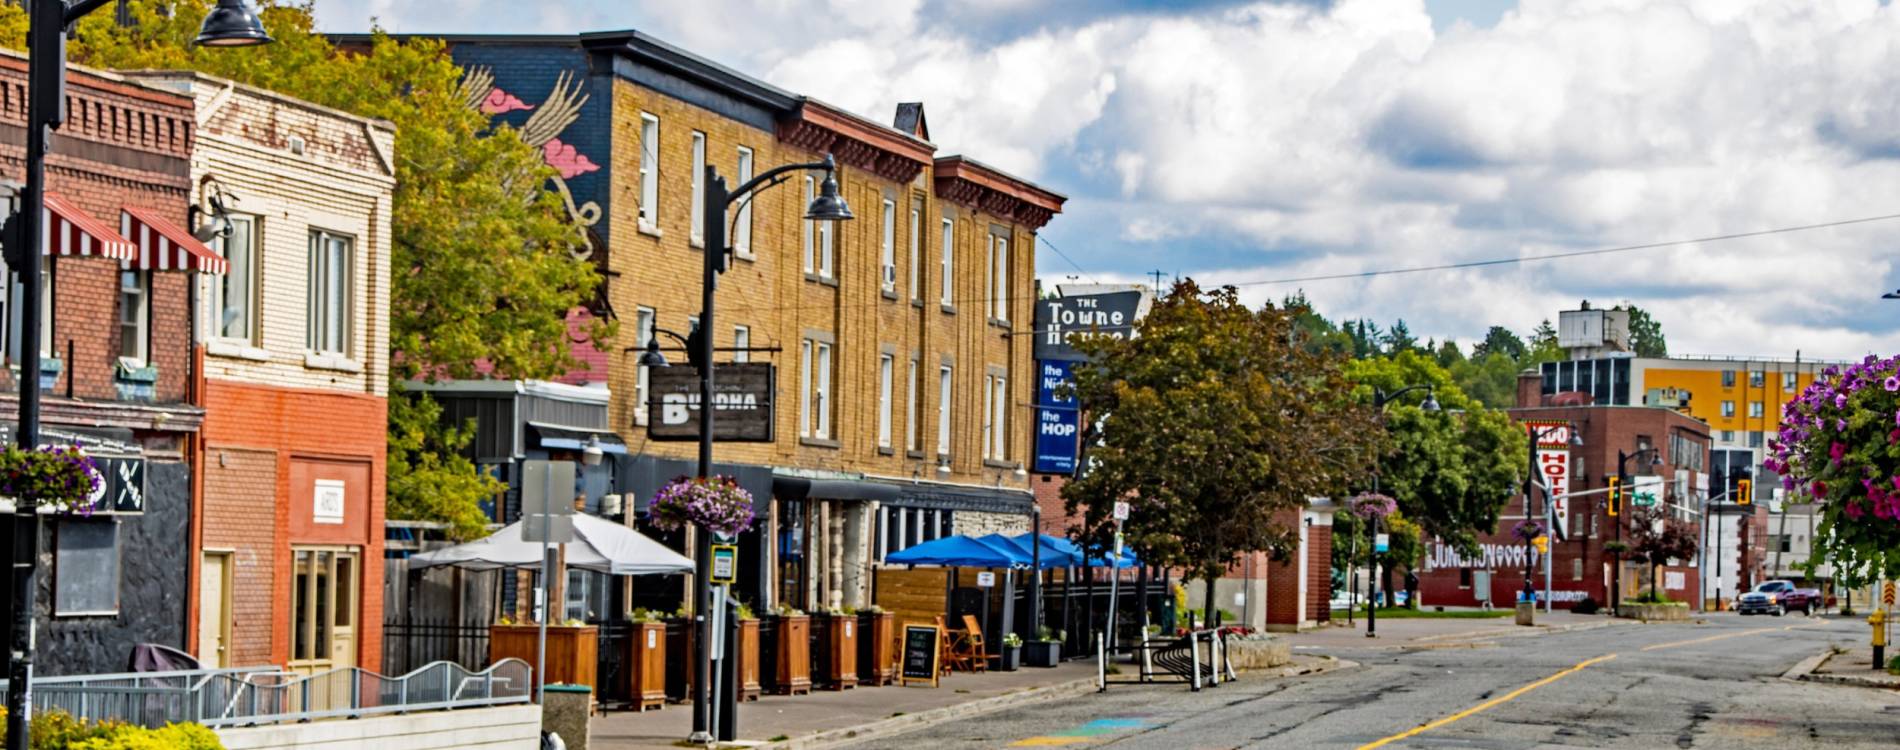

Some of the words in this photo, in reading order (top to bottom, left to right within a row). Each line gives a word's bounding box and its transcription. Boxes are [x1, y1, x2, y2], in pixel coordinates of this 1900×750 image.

[1076, 299, 1098, 308] THE
[1048, 302, 1124, 325] Towne
[1045, 364, 1063, 377] the
[663, 393, 757, 424] BUDHA
[1042, 410, 1060, 422] the
[1041, 422, 1076, 436] HOP
[1532, 425, 1568, 443] EDO
[1542, 454, 1566, 510] HOTEL
[1432, 535, 1496, 568] JUNCON
